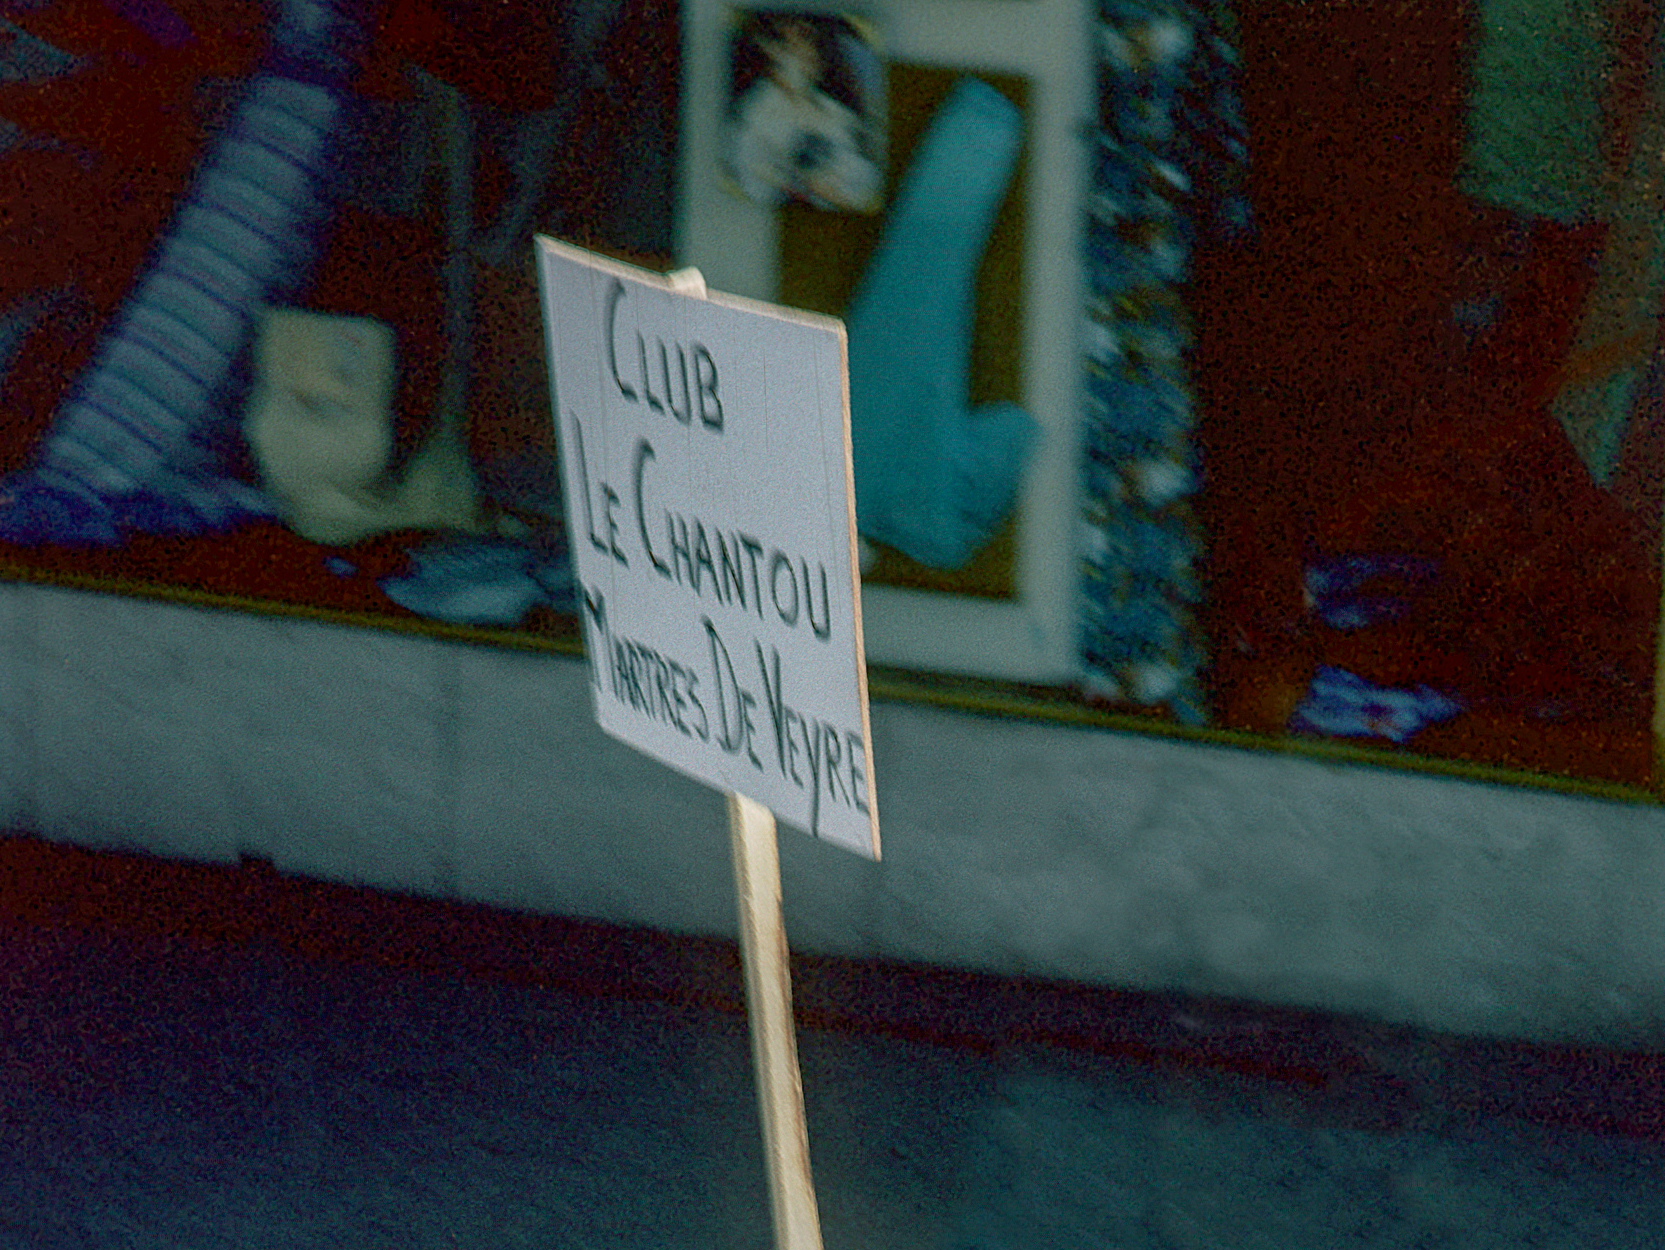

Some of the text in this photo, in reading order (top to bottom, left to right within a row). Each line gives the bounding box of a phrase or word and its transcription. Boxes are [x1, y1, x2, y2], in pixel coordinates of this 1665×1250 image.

[607, 278, 723, 431] CLUB
[569, 410, 831, 640] LE CHANTOU
[584, 587, 710, 743] MARTRES
